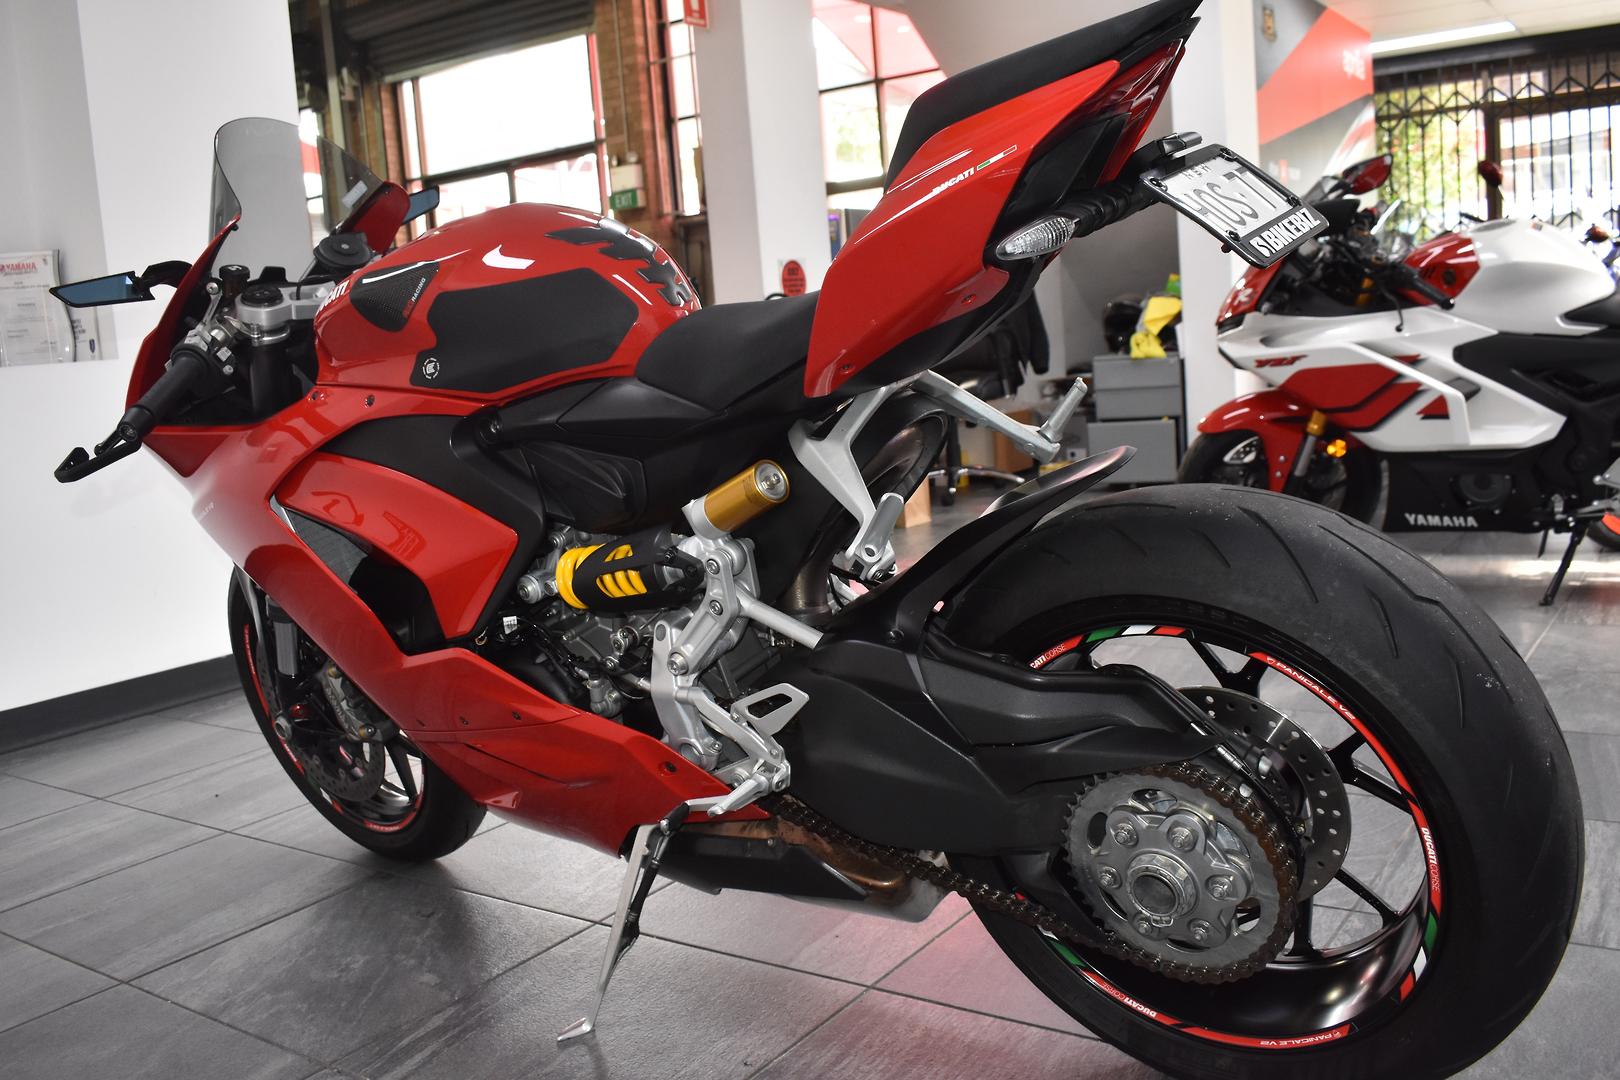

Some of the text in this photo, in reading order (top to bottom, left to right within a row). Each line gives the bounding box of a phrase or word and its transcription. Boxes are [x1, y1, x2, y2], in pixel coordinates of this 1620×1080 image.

[932, 167, 975, 195] DUCATI
[614, 192, 633, 208] EXIT
[1260, 207, 1321, 253] BIKEBIZ
[6, 262, 37, 272] YAMAHA
[411, 277, 426, 303] RACING
[1404, 512, 1478, 528] YAMAHA
[1044, 643, 1065, 660] CORSE
[1421, 827, 1440, 891] DUCATI CORSE
[1124, 997, 1157, 1018] DUCATI
